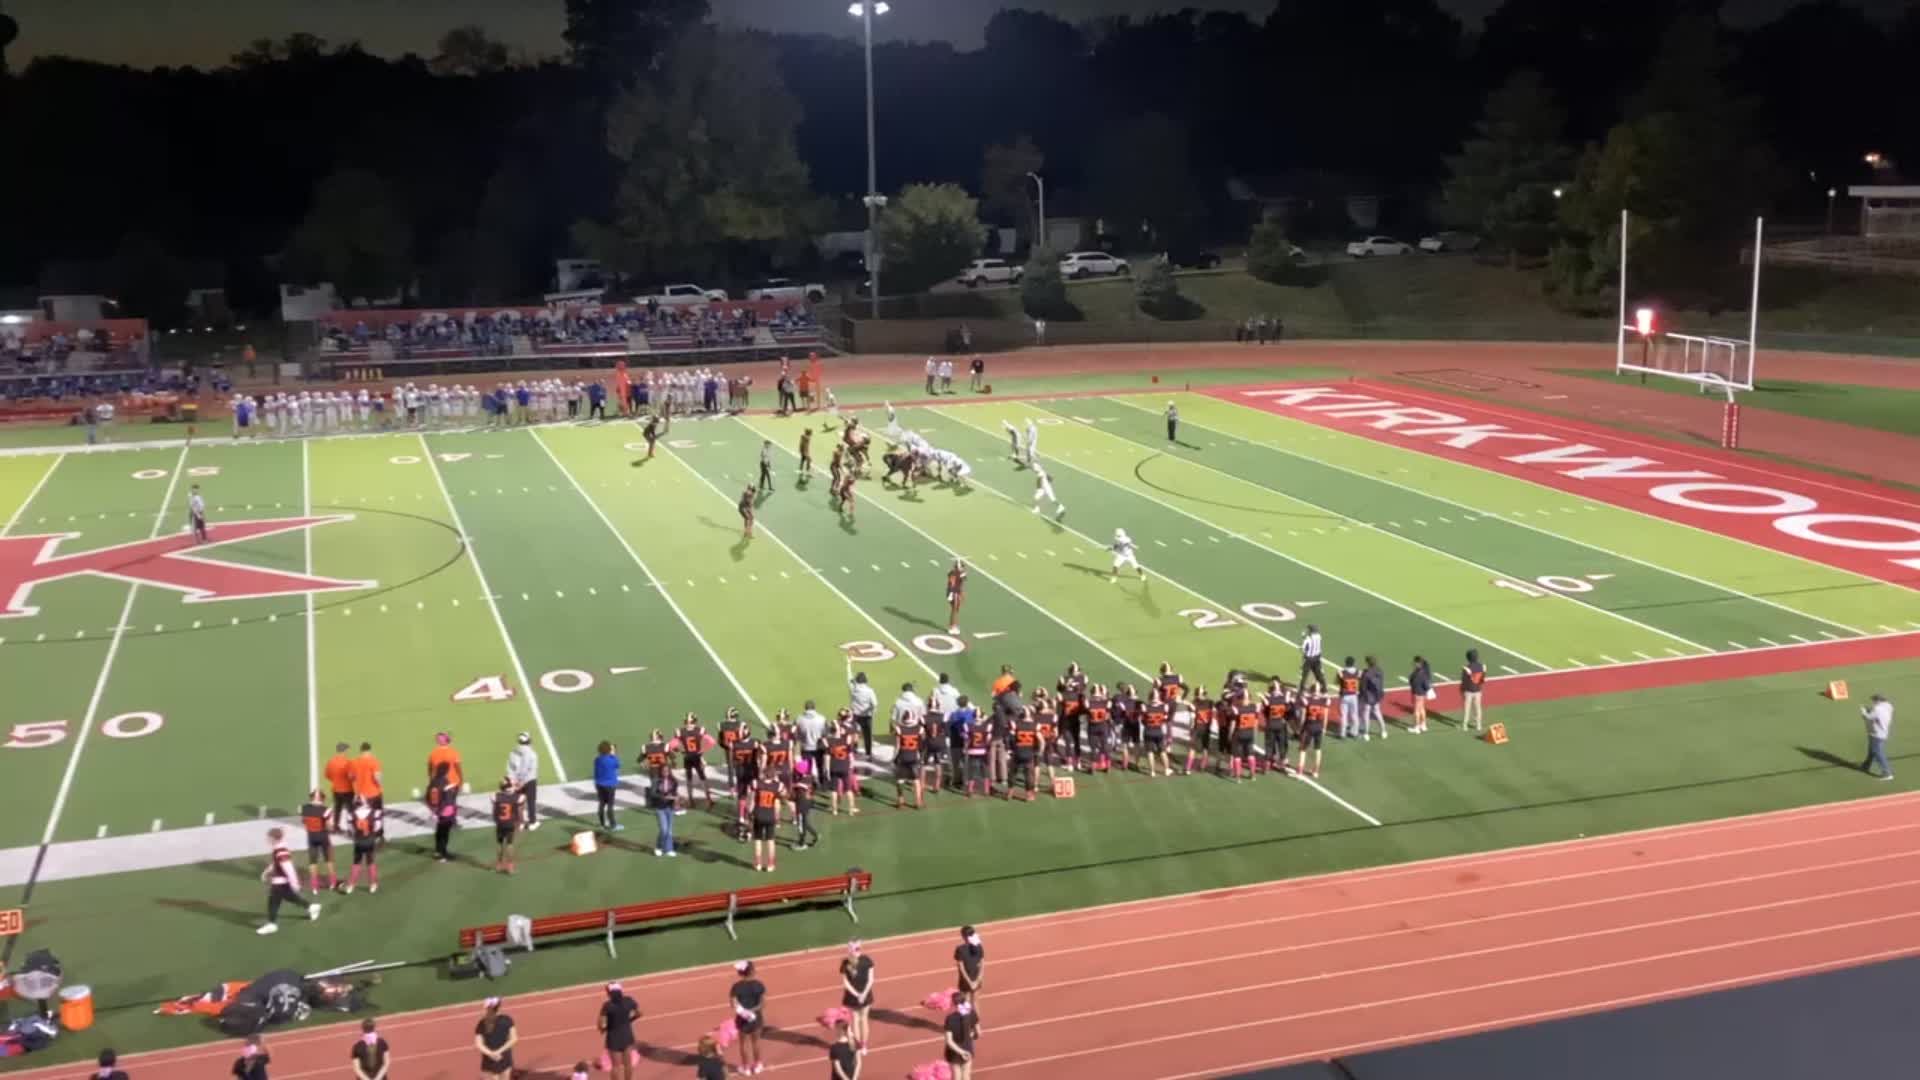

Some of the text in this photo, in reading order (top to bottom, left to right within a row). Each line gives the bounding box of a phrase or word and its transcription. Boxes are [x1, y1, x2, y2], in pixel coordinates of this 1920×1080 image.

[1243, 386, 1920, 573] KIRKWOO
[1491, 574, 1596, 600] 10
[1177, 603, 1297, 630] 20
[839, 632, 967, 664] 30
[450, 668, 597, 704] 40
[2, 710, 165, 750] 50
[0, 911, 20, 932] 50
